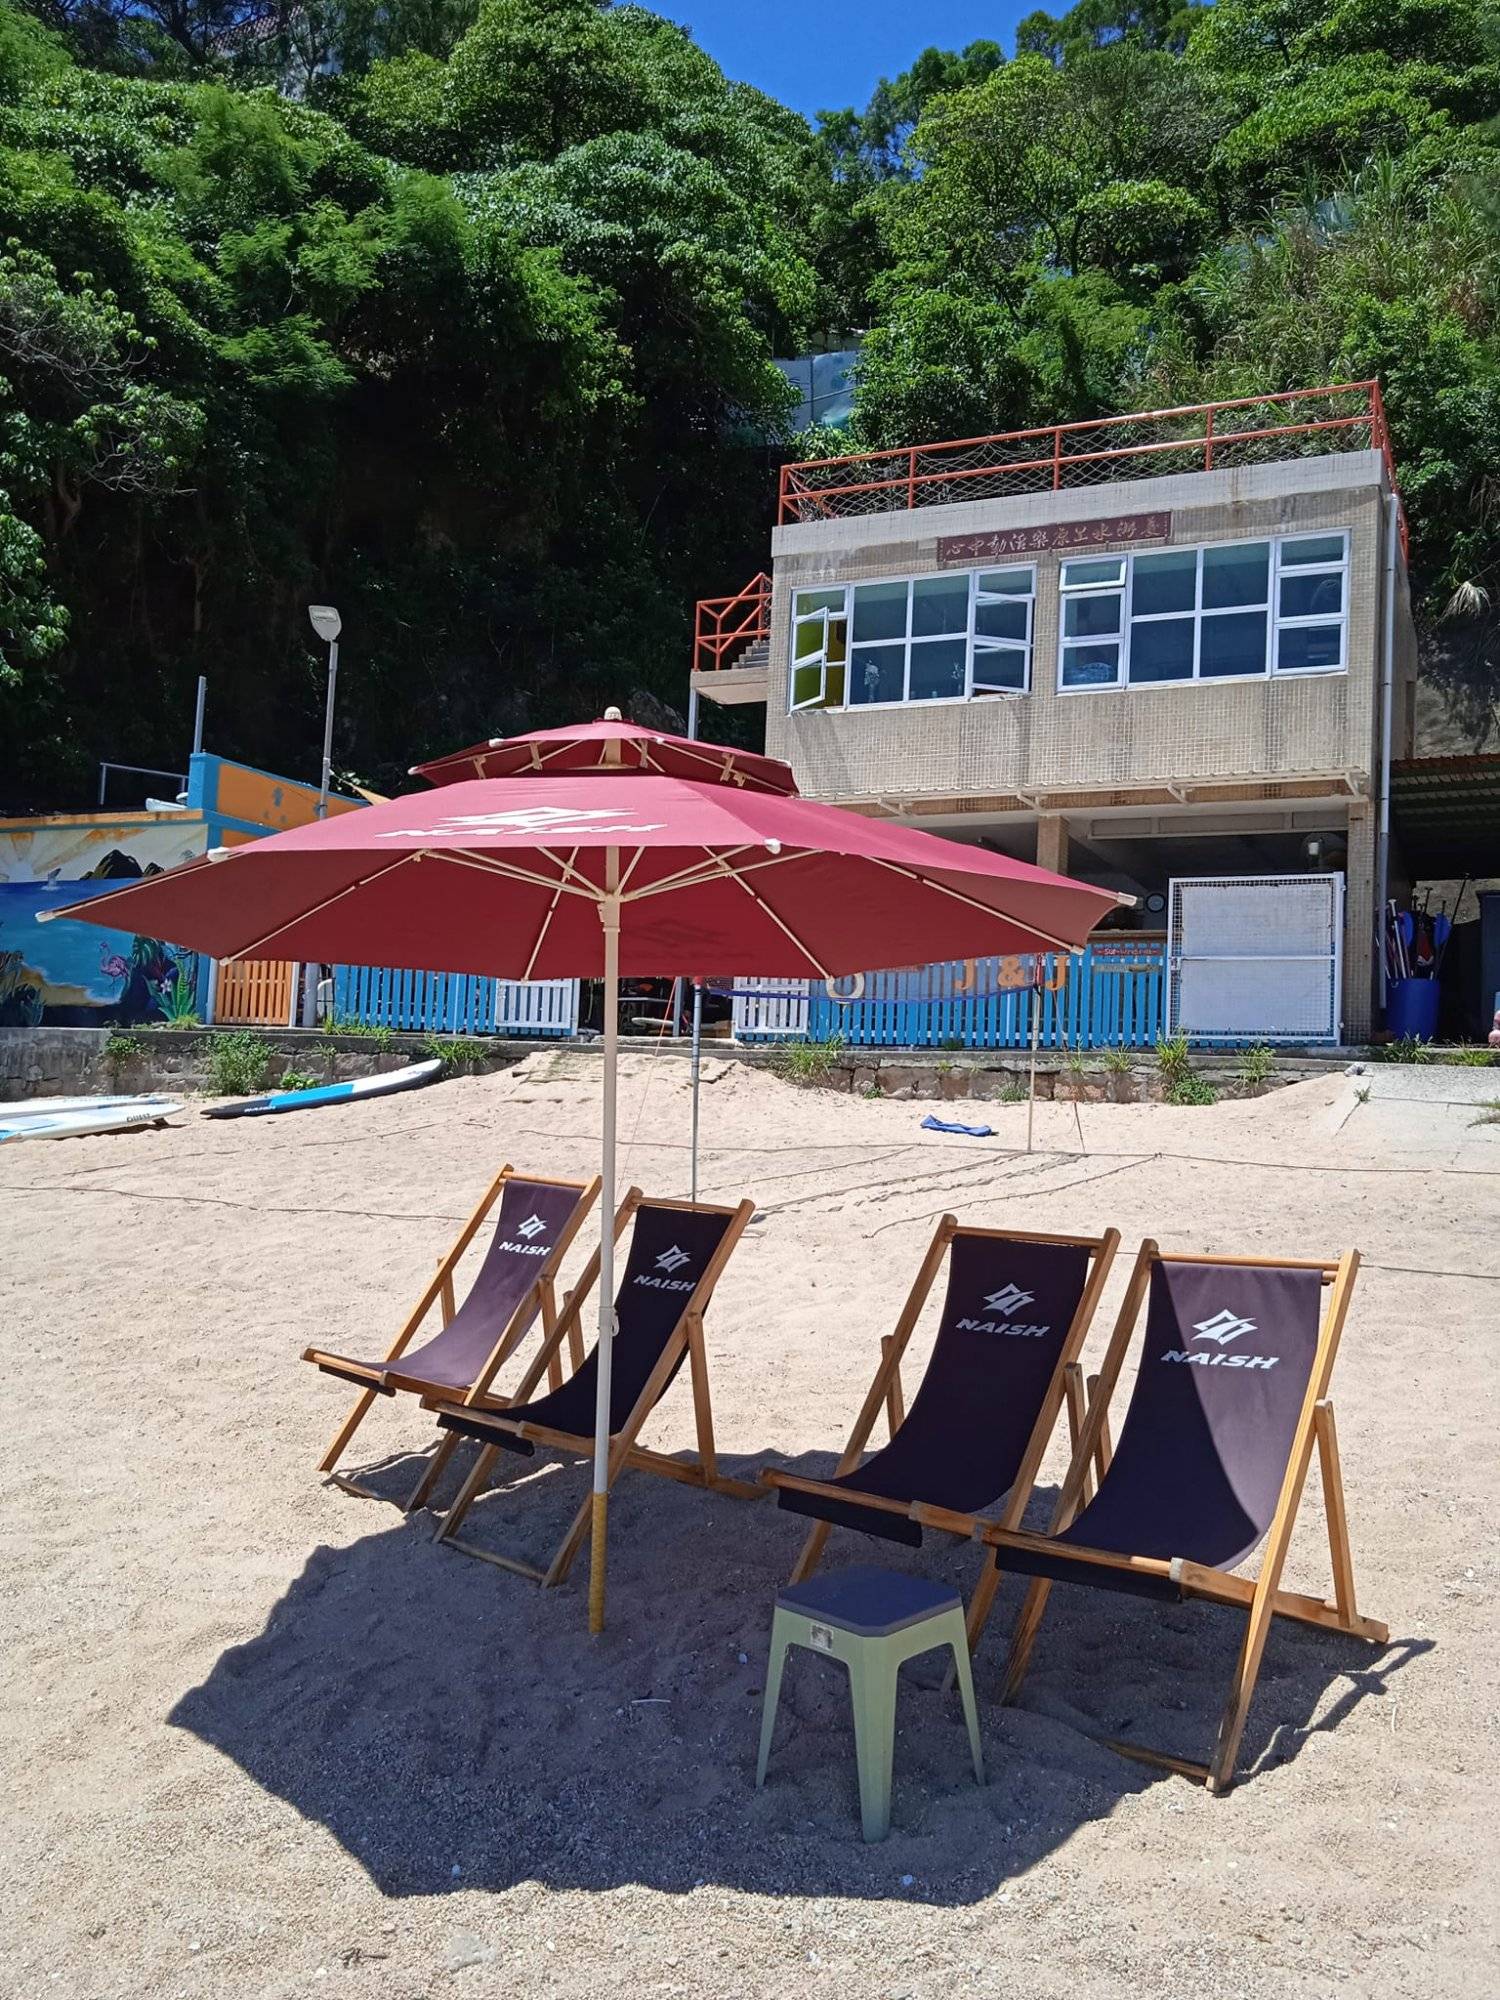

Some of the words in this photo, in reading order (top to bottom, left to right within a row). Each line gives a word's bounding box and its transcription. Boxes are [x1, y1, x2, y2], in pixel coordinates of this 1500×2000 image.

[997, 954, 1025, 987] &
[1044, 954, 1069, 991] J
[499, 1240, 552, 1257] NAISH
[633, 1273, 697, 1292] NAISH
[955, 1317, 1050, 1338] NAISH
[1160, 1349, 1281, 1370] NAISH
